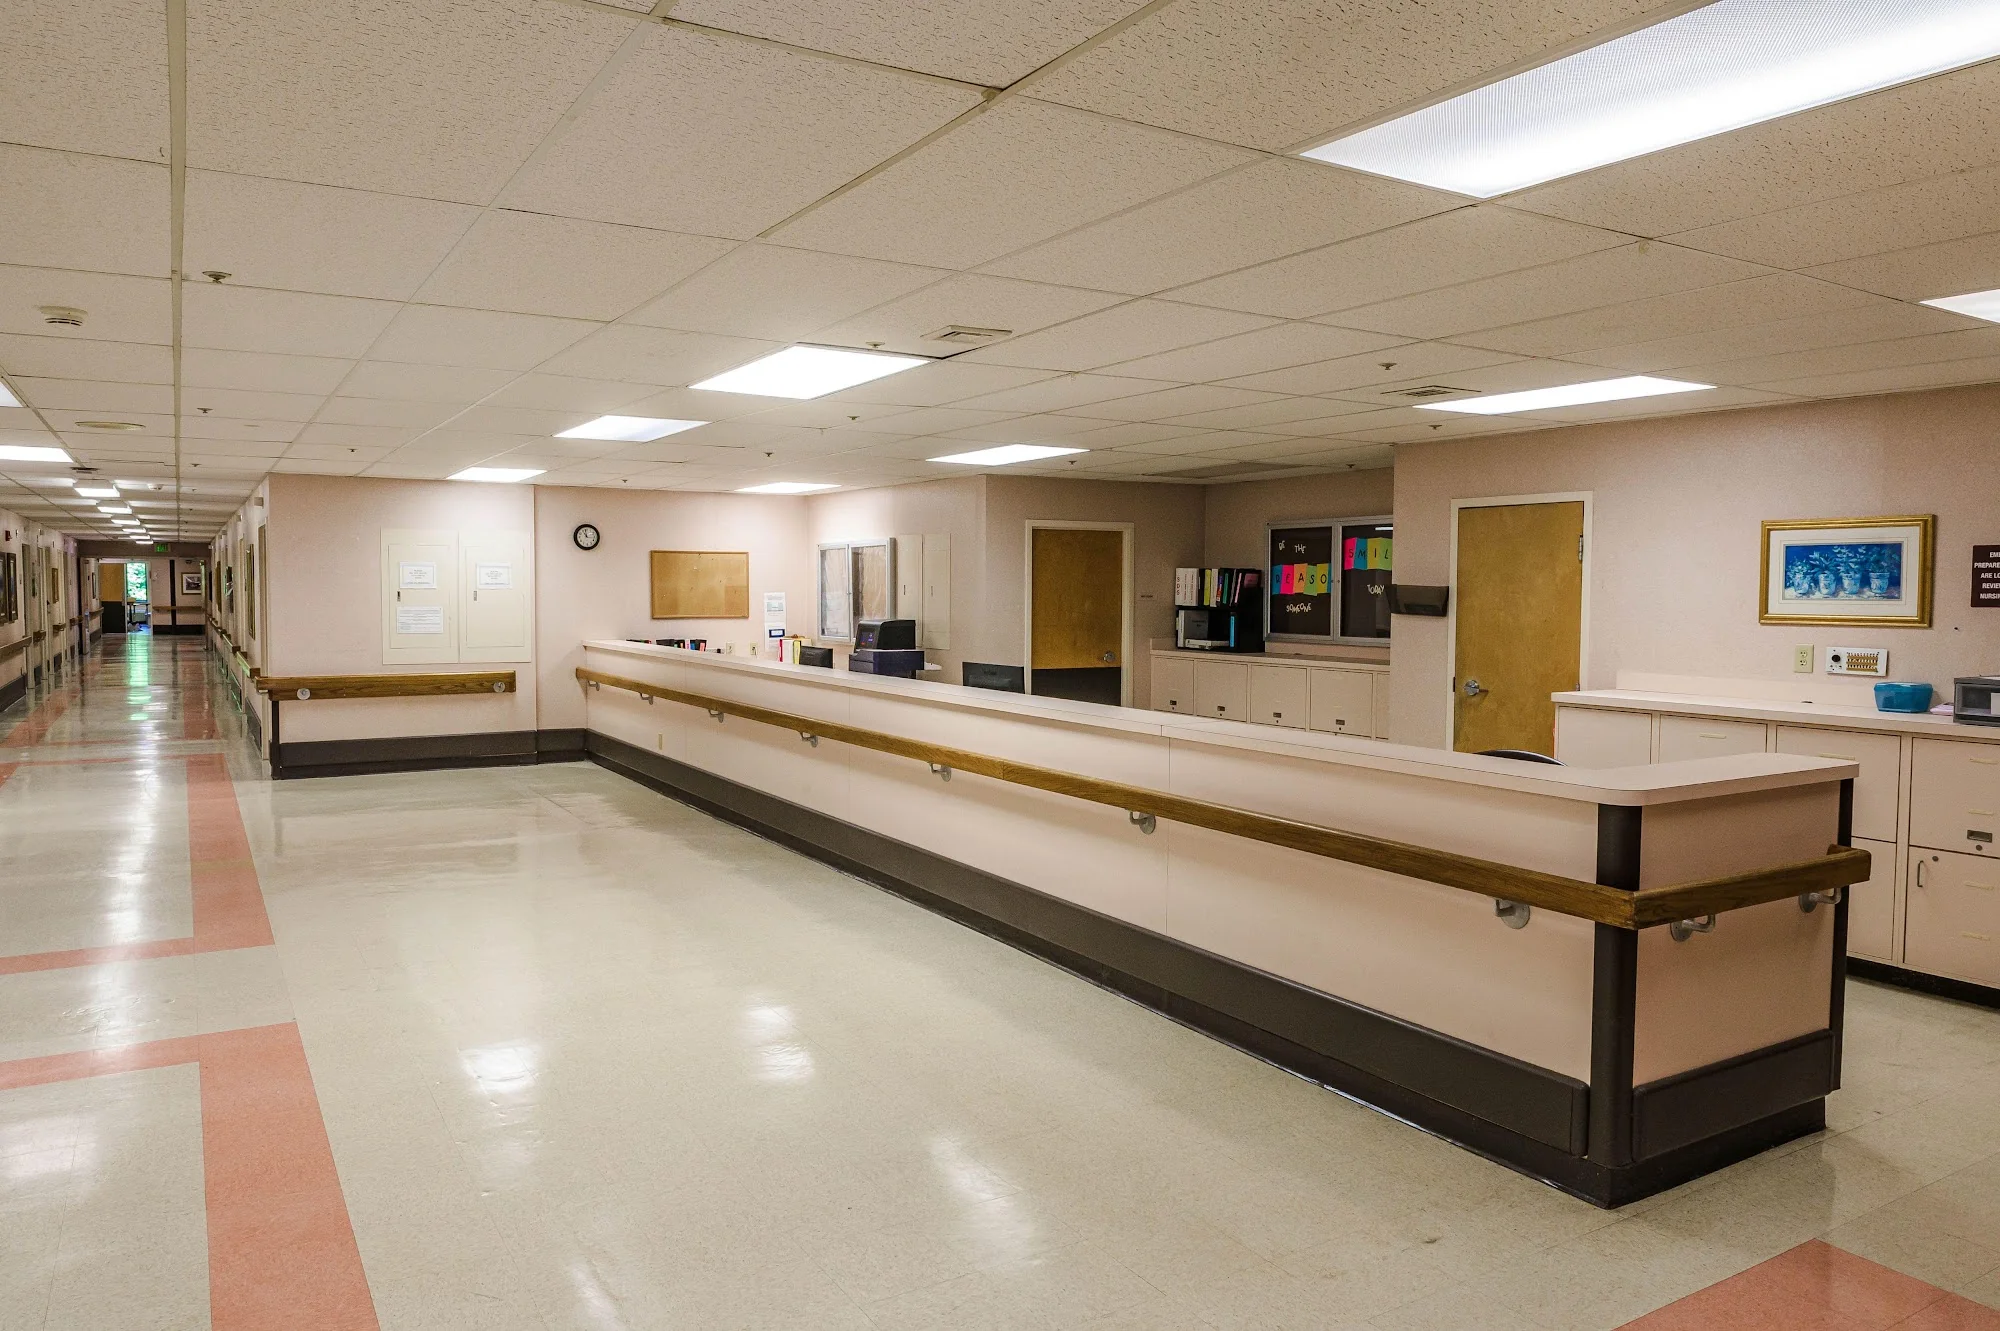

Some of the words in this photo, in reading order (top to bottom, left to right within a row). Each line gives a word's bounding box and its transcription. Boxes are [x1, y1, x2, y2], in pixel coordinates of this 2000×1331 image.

[1294, 543, 1307, 554] THE
[1366, 584, 1385, 595] TODAY
[1286, 602, 1312, 614] SOMEONE
